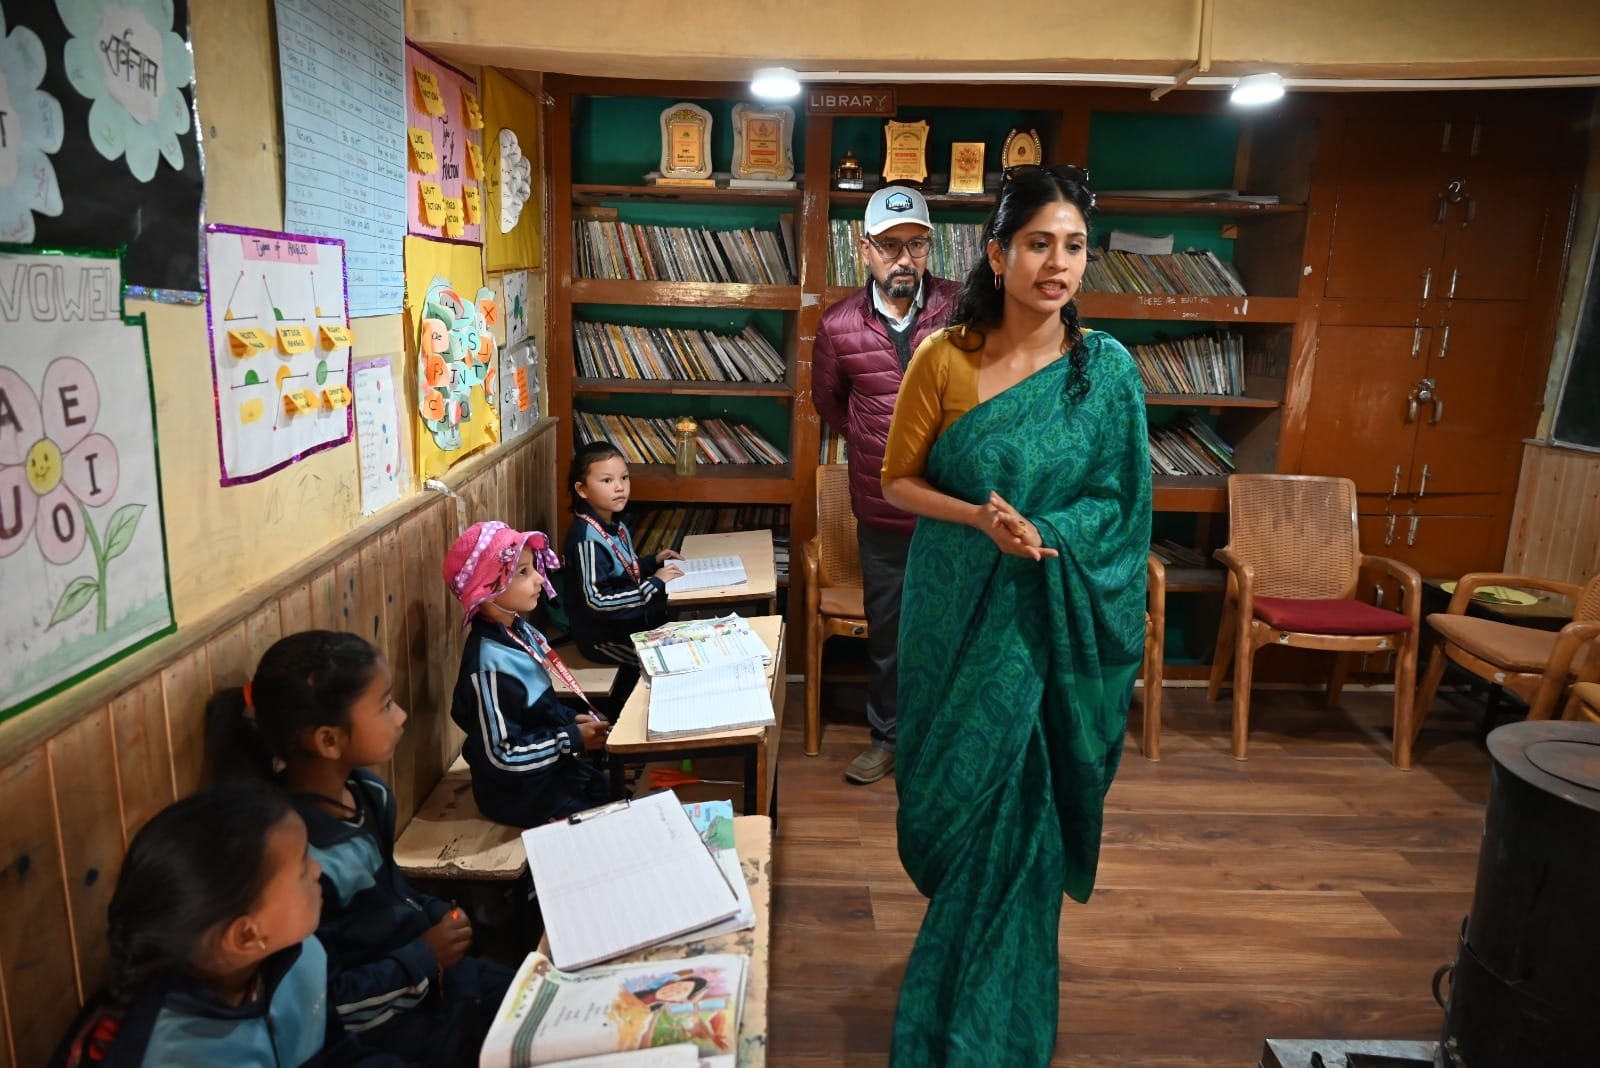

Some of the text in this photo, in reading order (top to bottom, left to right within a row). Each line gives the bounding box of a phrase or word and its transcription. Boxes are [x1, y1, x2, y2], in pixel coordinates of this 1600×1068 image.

[811, 95, 888, 107] LIBRARY
[0, 264, 120, 322] VOWEL
[483, 305, 495, 322] X
[468, 332, 477, 351] S
[58, 384, 87, 427] E
[428, 399, 438, 411] C
[84, 452, 101, 496] I
[0, 485, 24, 539] U
[52, 502, 75, 543] O
